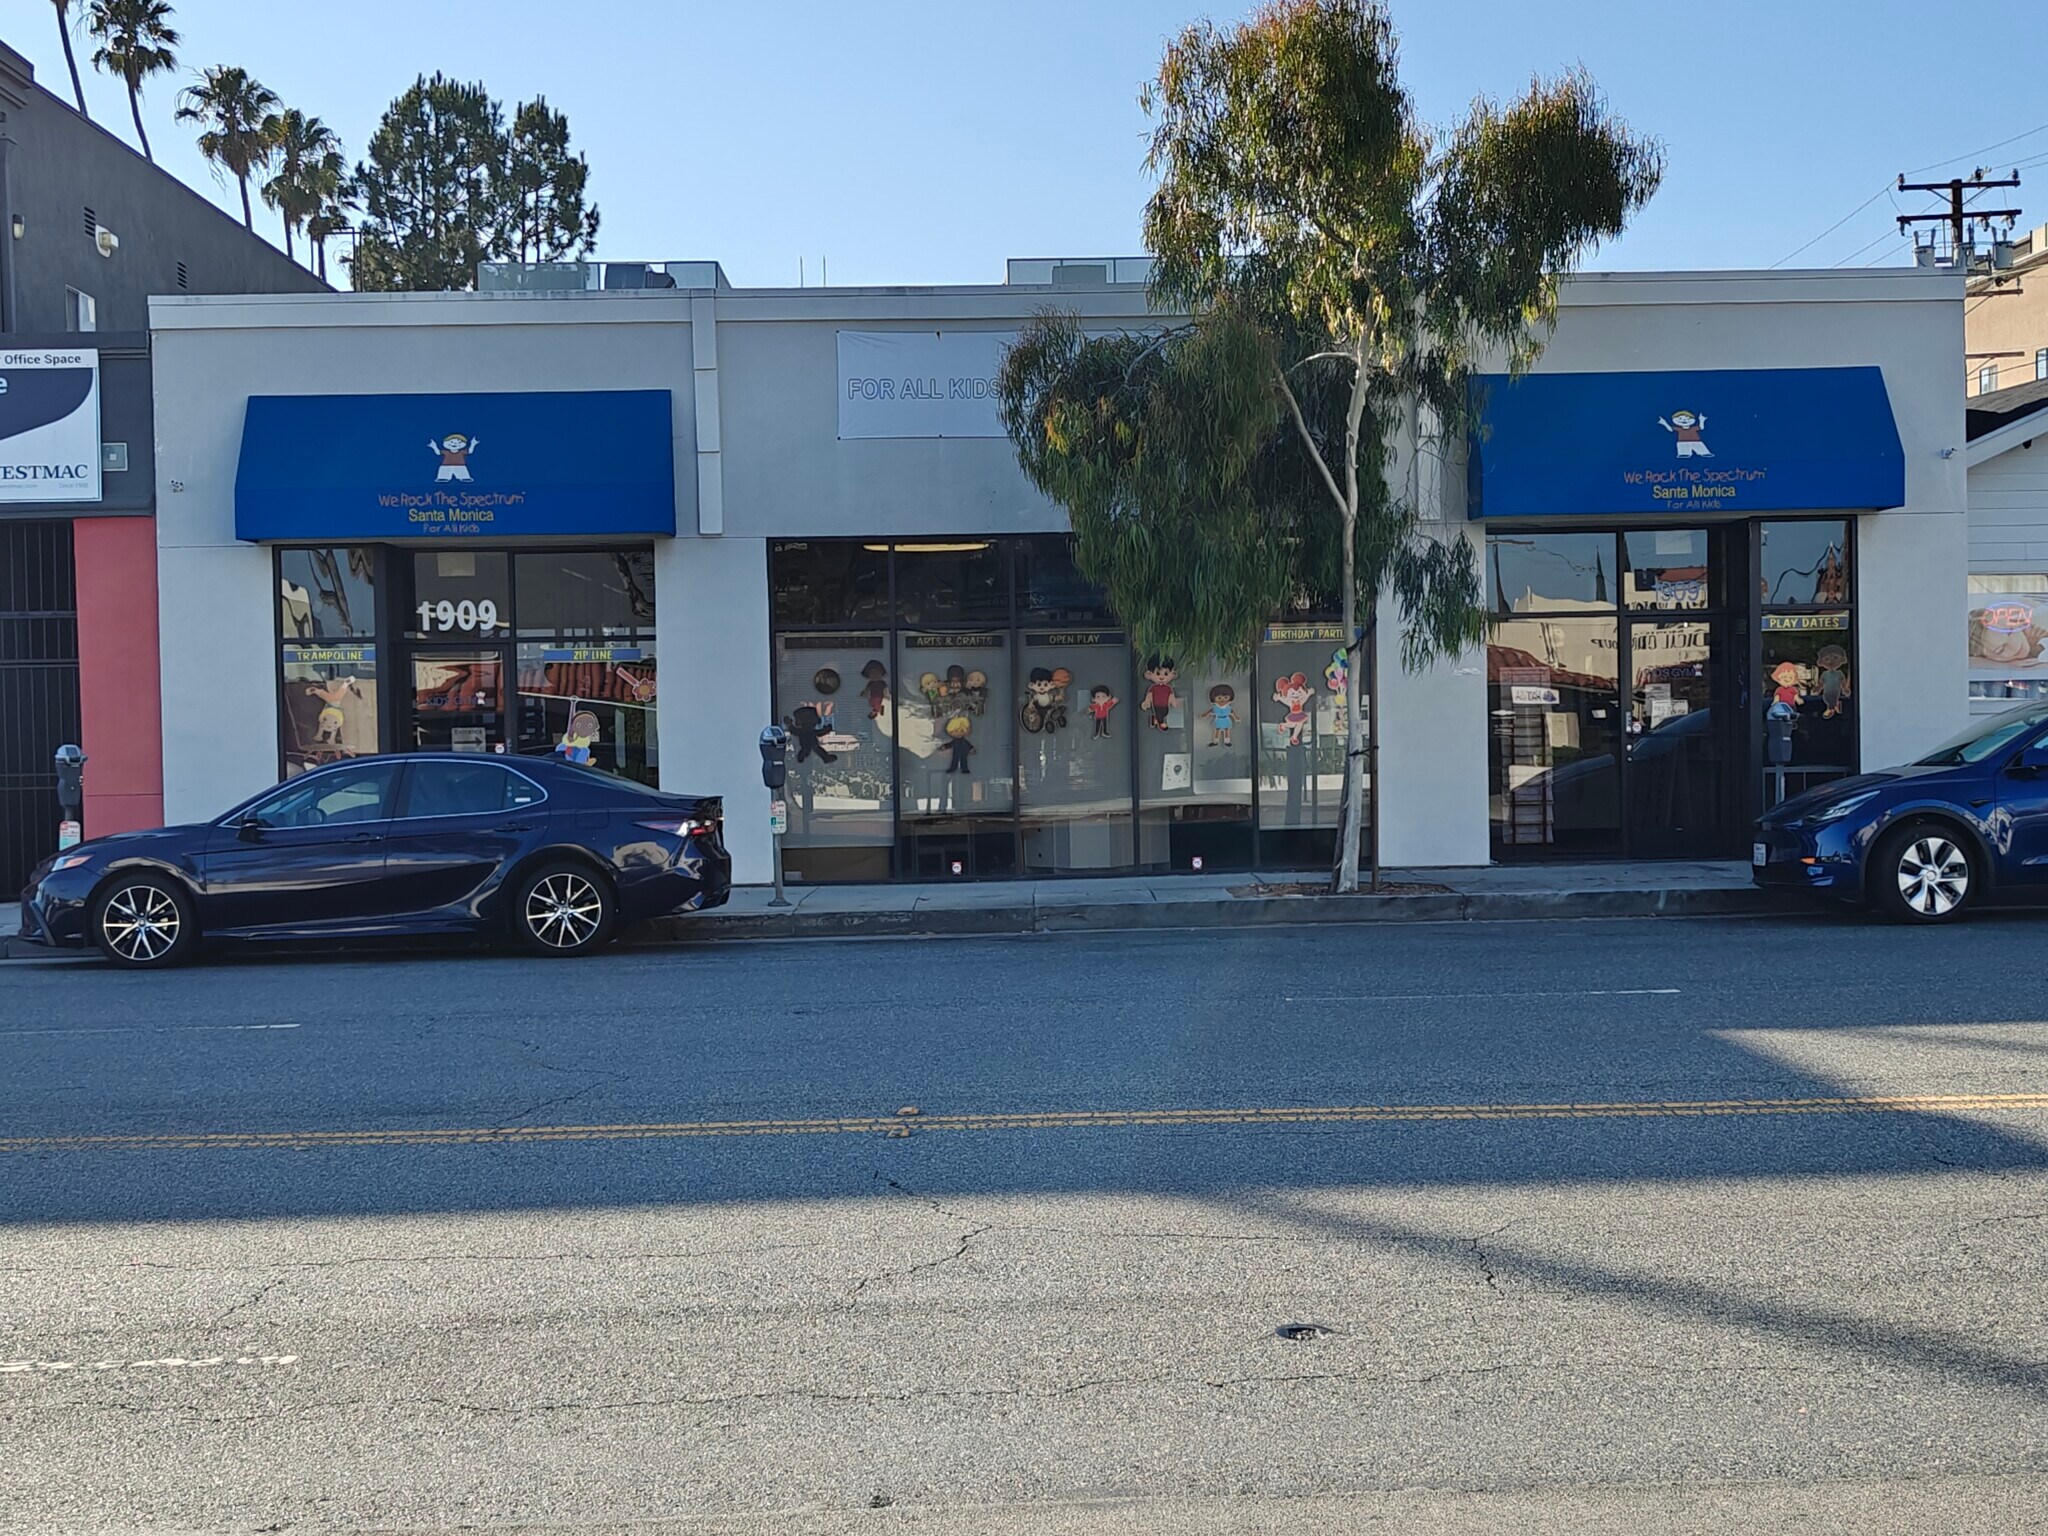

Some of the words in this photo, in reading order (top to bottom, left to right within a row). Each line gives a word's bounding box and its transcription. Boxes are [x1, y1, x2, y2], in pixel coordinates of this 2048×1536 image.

[4, 354, 41, 365] Office
[44, 353, 81, 366] Space
[848, 378, 895, 400] FOR
[900, 378, 944, 399] ALL
[949, 377, 1002, 399] KIDS
[0, 464, 88, 480] ESTMAC
[1623, 471, 1643, 484] We
[1645, 469, 1676, 484] Rock
[1678, 467, 1700, 483] The
[1703, 466, 1766, 483] Spectrum
[1652, 485, 1688, 499] Santa
[1691, 484, 1736, 498] Monica
[378, 494, 400, 507] We
[400, 492, 433, 507] Rock
[434, 490, 458, 507] The
[459, 490, 525, 508] Spectrum
[1666, 501, 1683, 509] For
[408, 508, 446, 522] Santa
[449, 508, 494, 521] Monica
[423, 524, 441, 533] For
[416, 599, 497, 631] 1909
[1982, 608, 2032, 626] OPEN
[1769, 618, 1798, 629] PLAY
[1802, 617, 1839, 628] DATES
[917, 637, 941, 646] ARTS
[944, 637, 953, 646] &
[956, 636, 993, 646] CRAFTS
[1049, 634, 1074, 644] OPEN
[1077, 634, 1100, 643] PLAY
[1271, 629, 1315, 640] BIRTHDAY
[297, 650, 364, 661] TRAMPOLINE
[573, 650, 588, 660] ZIP
[591, 650, 613, 660] LINE
